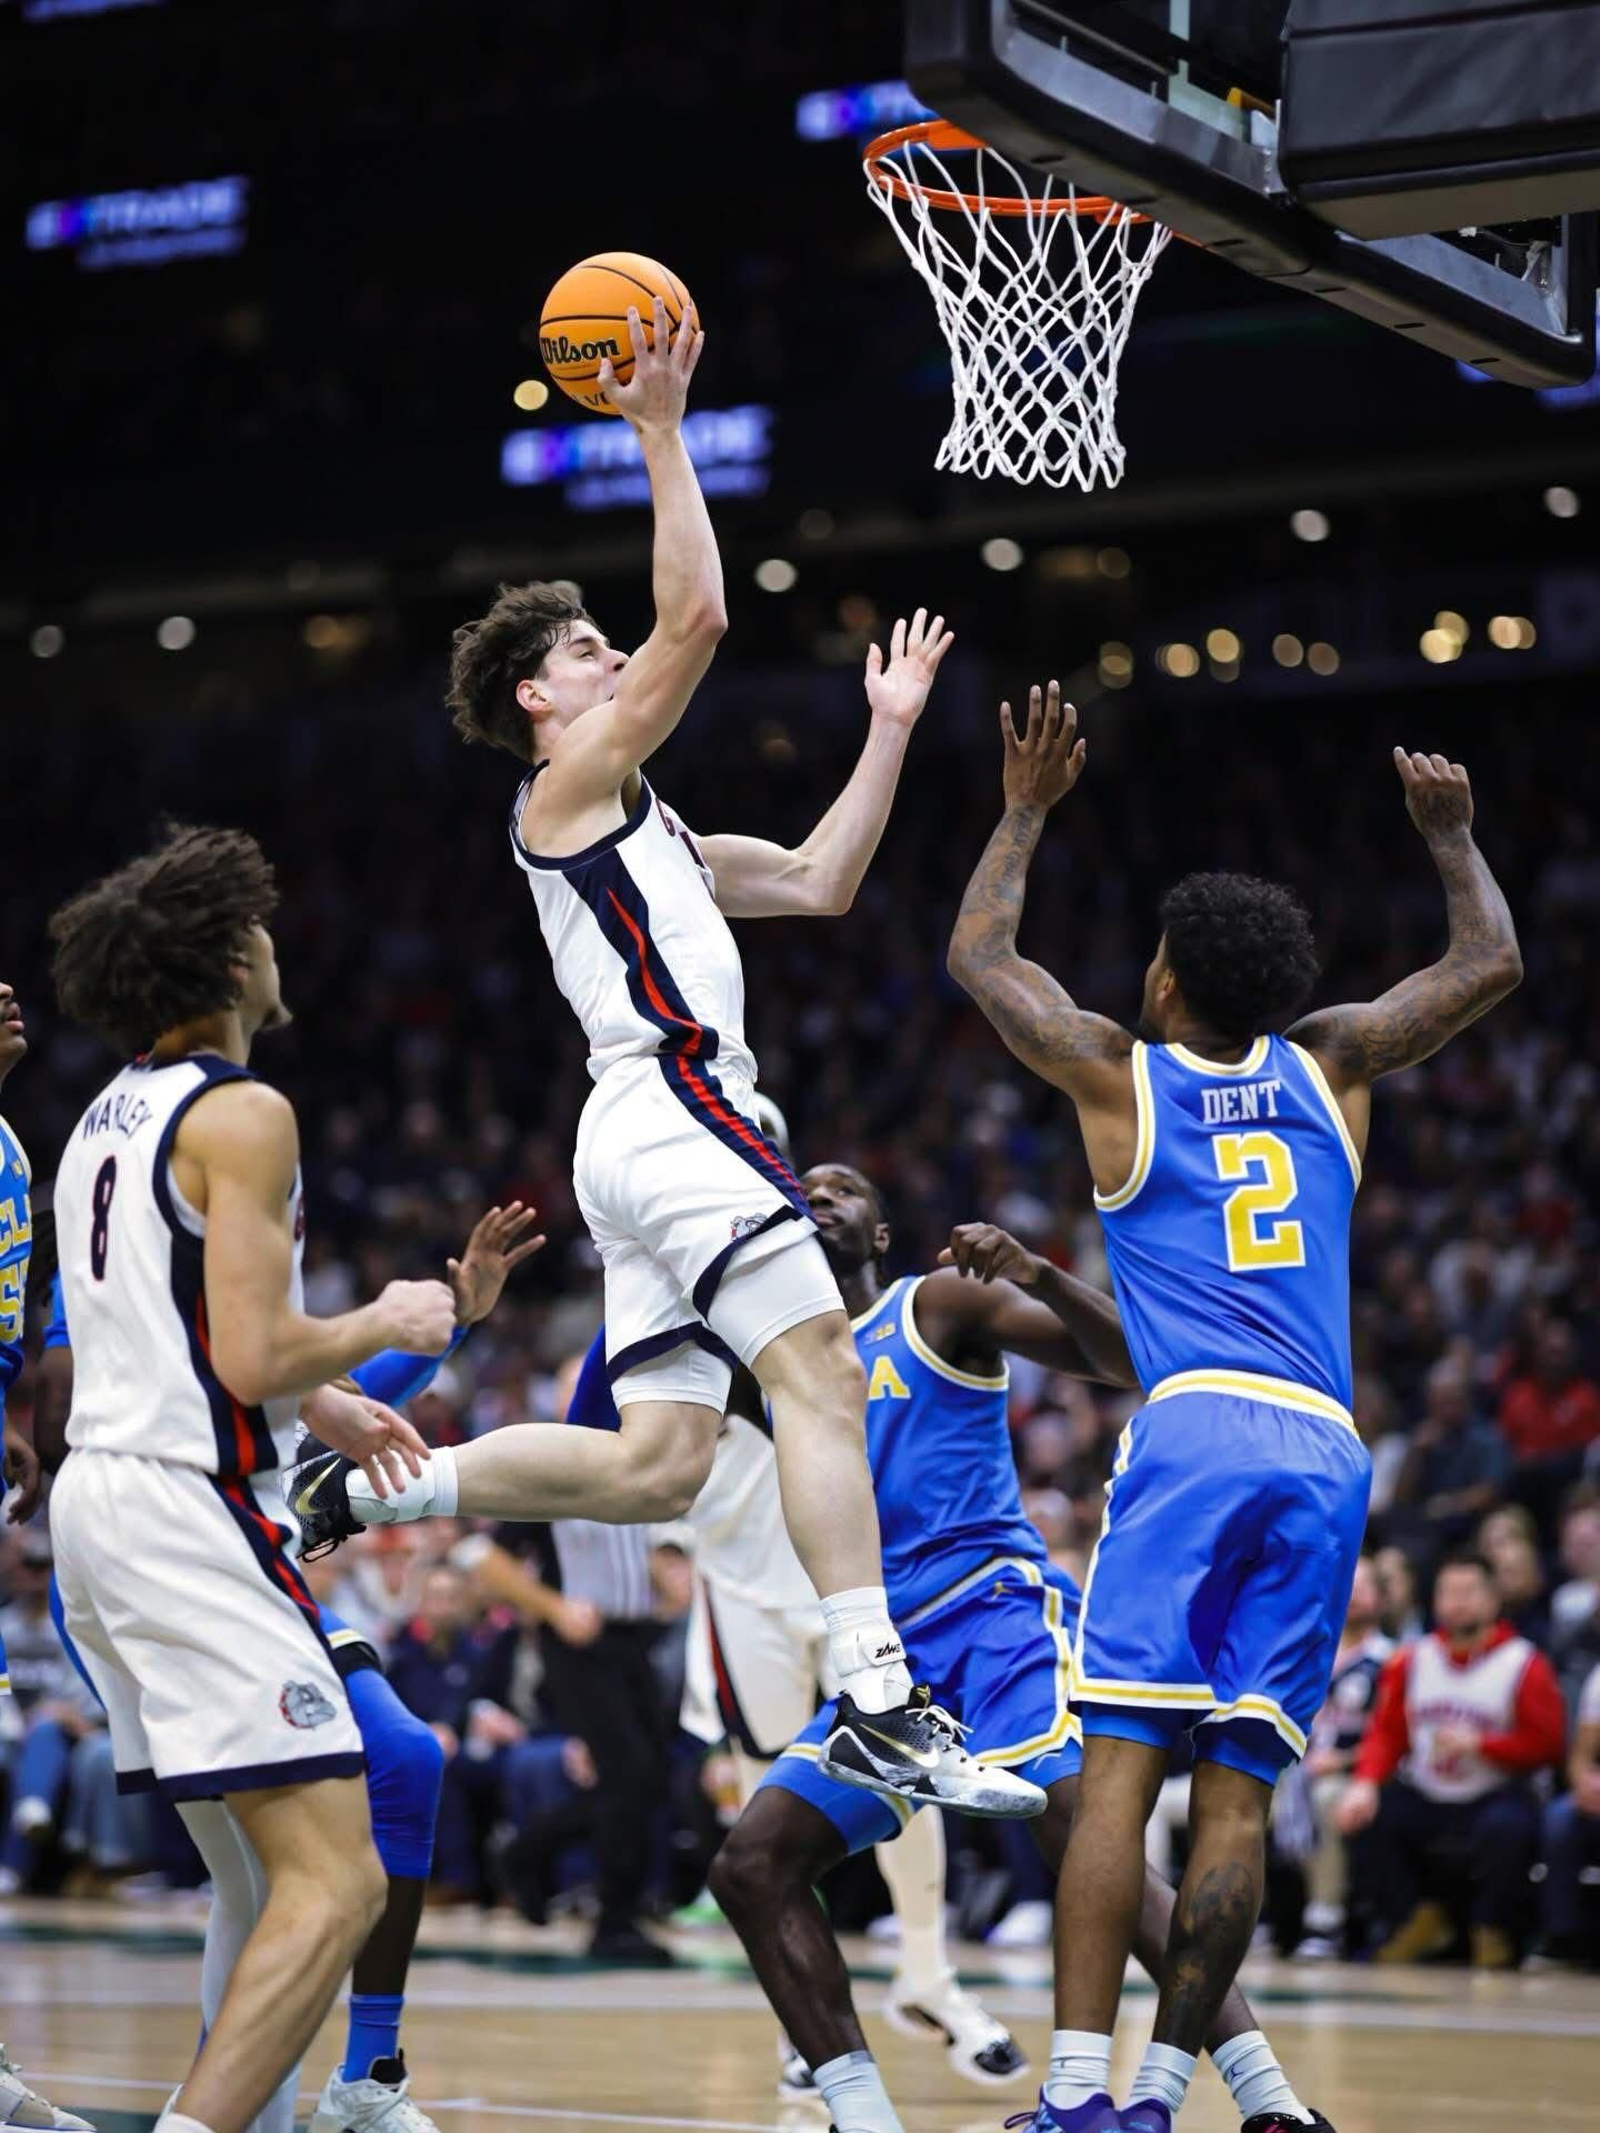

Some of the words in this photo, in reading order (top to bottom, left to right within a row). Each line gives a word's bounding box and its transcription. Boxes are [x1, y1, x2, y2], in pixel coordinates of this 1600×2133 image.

[1201, 1080, 1281, 1125] DENT
[91, 1154, 117, 1281] 8
[1212, 1131, 1306, 1272] 2
